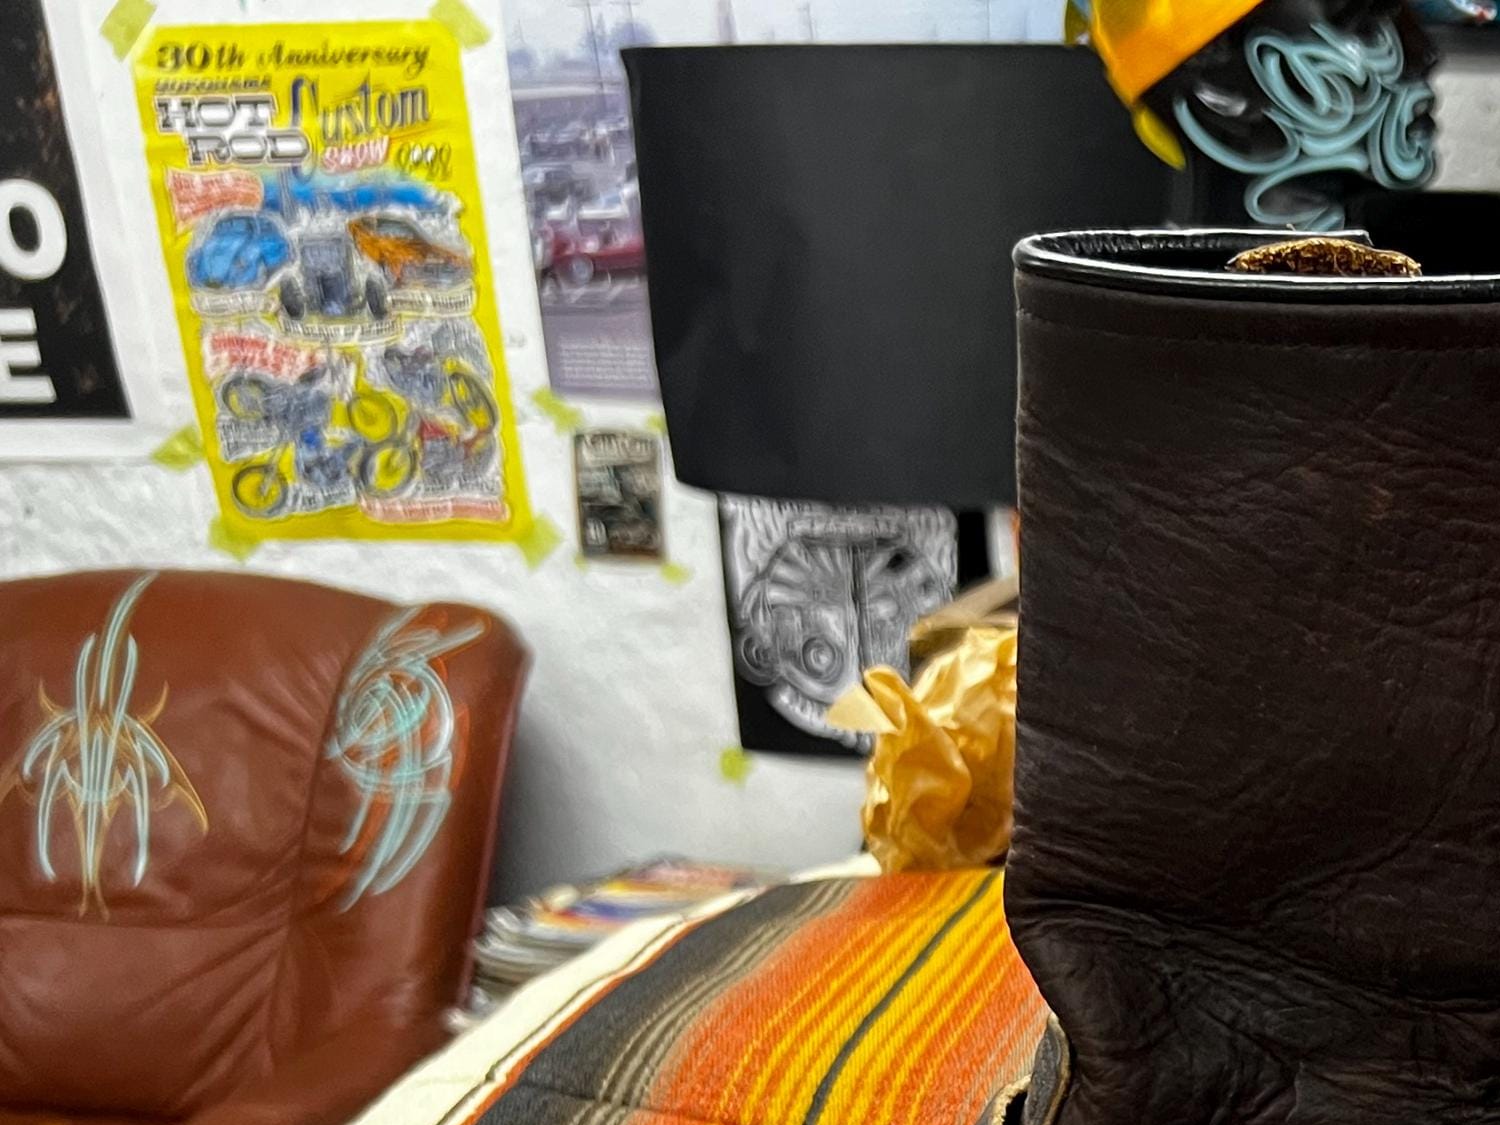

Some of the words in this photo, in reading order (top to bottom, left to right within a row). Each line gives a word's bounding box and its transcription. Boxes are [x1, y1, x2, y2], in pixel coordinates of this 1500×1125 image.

[157, 42, 246, 71] 30th
[257, 41, 430, 80] Anniversary
[155, 95, 278, 133] HOT
[188, 129, 311, 165] ROD
